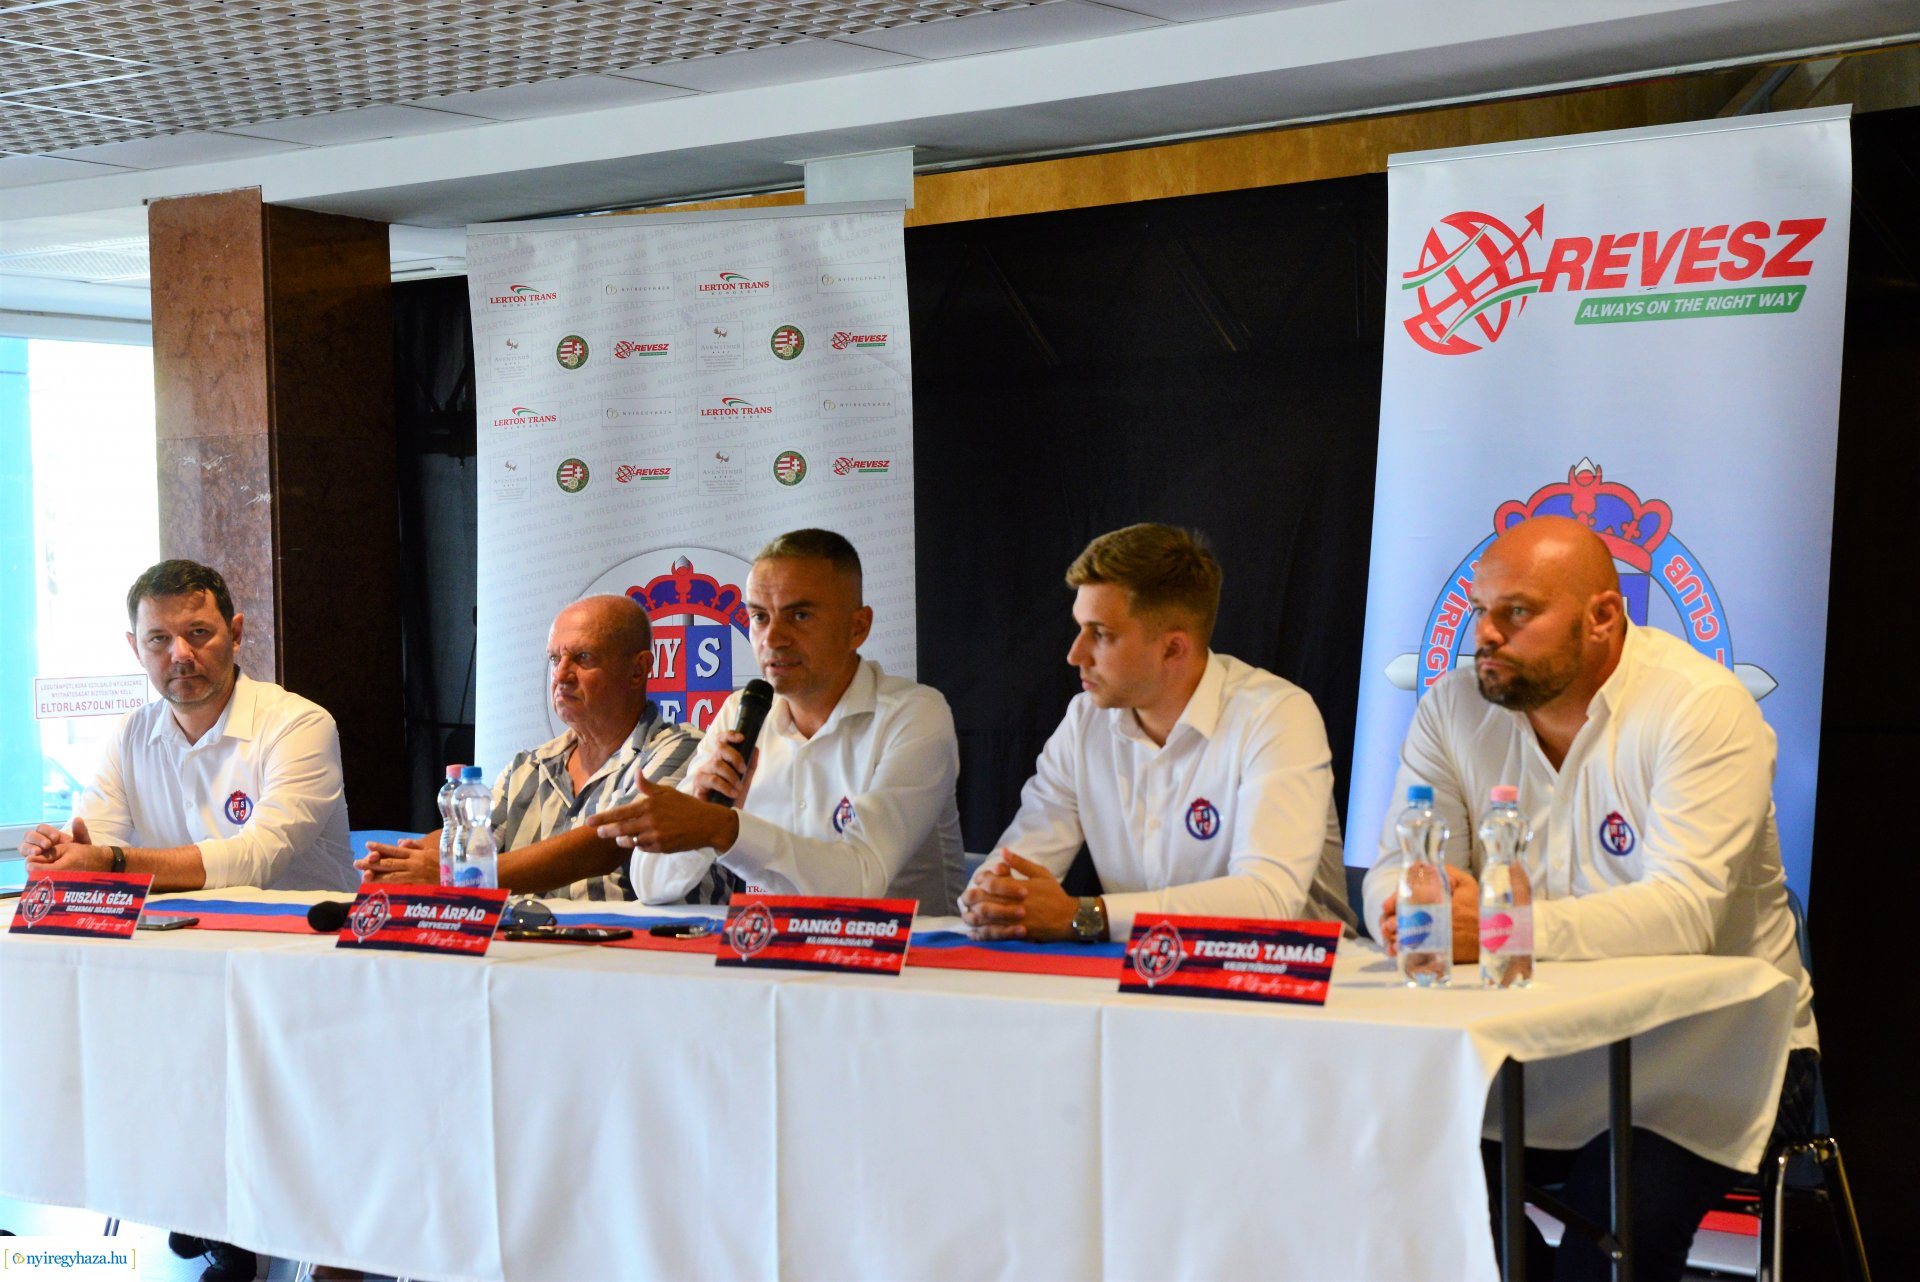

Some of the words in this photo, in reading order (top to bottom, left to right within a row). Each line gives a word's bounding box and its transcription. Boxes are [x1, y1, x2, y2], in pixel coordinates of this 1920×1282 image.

[1540, 217, 1828, 293] REVESZ
[699, 283, 736, 292] LERTON
[738, 281, 770, 290] TRANS
[490, 295, 527, 305] LERTON
[529, 292, 557, 302] TRANS
[1581, 299, 1644, 319] ALWAYS
[1647, 299, 1670, 316] ON
[1674, 297, 1704, 314] THE
[1706, 294, 1756, 312] RIGHT
[1758, 291, 1800, 309] WAY
[851, 334, 888, 343] REVESZ
[633, 343, 669, 352] REVESZ
[701, 408, 738, 417] LERTON
[740, 406, 773, 415] TRANS
[493, 417, 526, 427] LERTON
[528, 414, 557, 424] TRANS
[635, 467, 672, 476] REVESZ
[853, 460, 891, 469] REVESZ
[1662, 554, 1720, 642] CLUB
[695, 637, 721, 679] S
[106, 891, 134, 906] GÉZA
[403, 903, 438, 919] KÓSA
[440, 904, 486, 921] ÁRPÁD
[787, 917, 842, 935] DANKÓ
[845, 919, 899, 938] GERGŐ
[1193, 940, 1260, 960] FECZKÓ
[1264, 943, 1327, 963] TAMÁS
